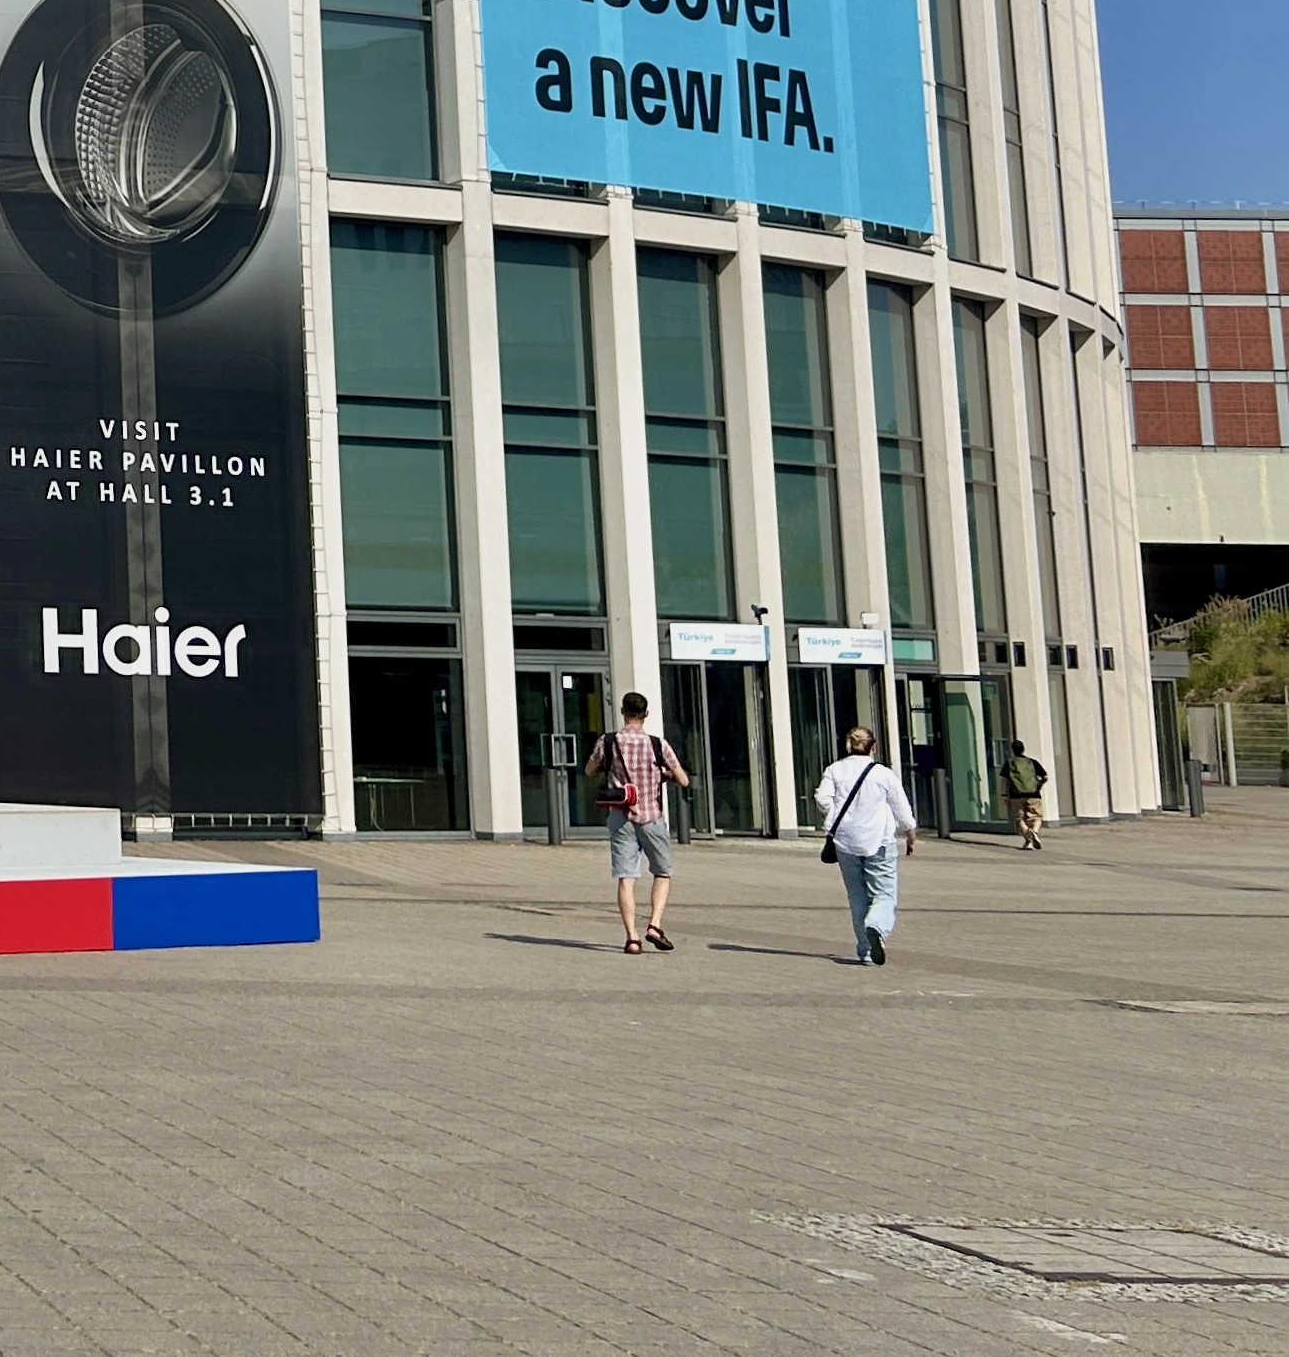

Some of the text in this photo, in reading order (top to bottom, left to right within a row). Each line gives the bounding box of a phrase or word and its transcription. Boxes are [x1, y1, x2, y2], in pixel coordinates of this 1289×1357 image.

[535, 48, 834, 154] a new IFA.
[99, 419, 179, 441] VISIT
[10, 447, 265, 476] HAIER PAVILLON
[46, 481, 234, 507] AT HALL 3.1
[42, 606, 246, 678] Haier
